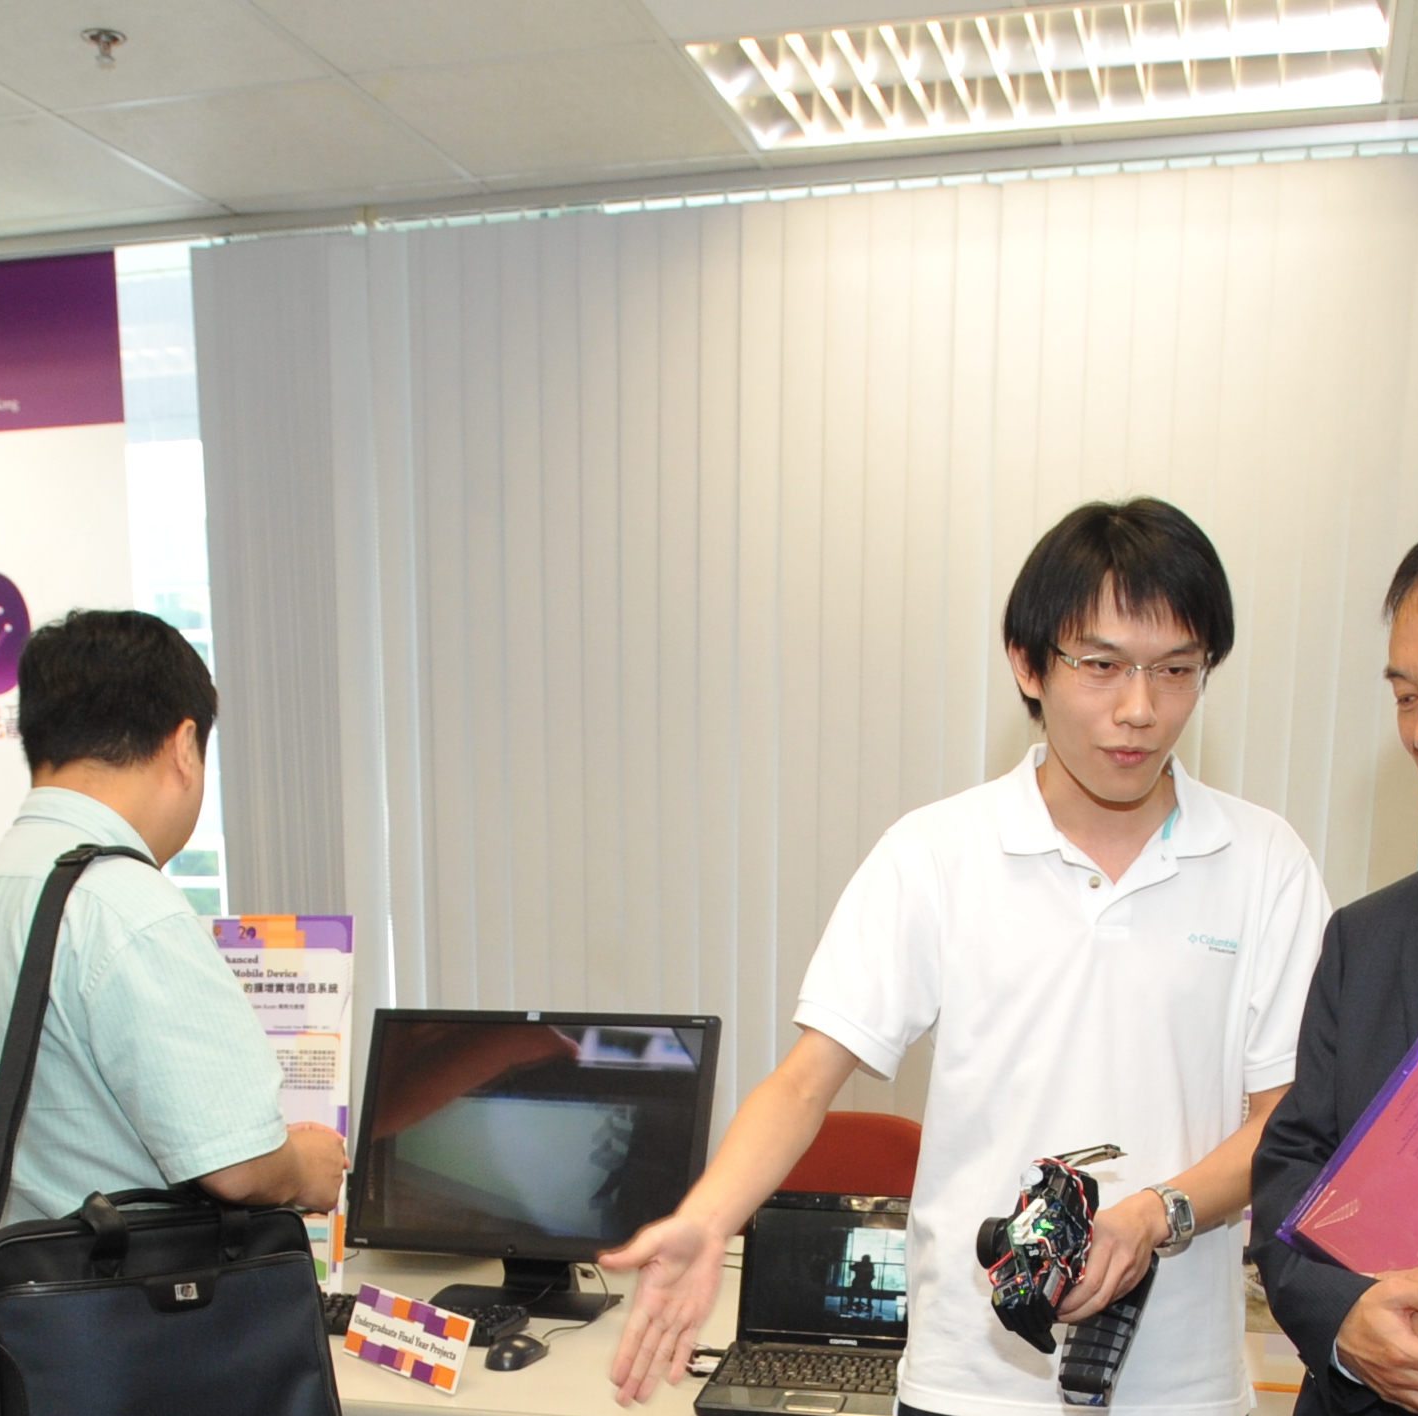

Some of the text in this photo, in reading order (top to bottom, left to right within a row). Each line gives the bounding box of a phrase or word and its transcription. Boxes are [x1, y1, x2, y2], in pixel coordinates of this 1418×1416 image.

[238, 926, 256, 940] 20
[1200, 934, 1238, 949] Columbia
[225, 955, 259, 964] hanced
[233, 969, 298, 978] Mobile Device
[354, 1314, 457, 1360] Undergraduate Final Year Projects
